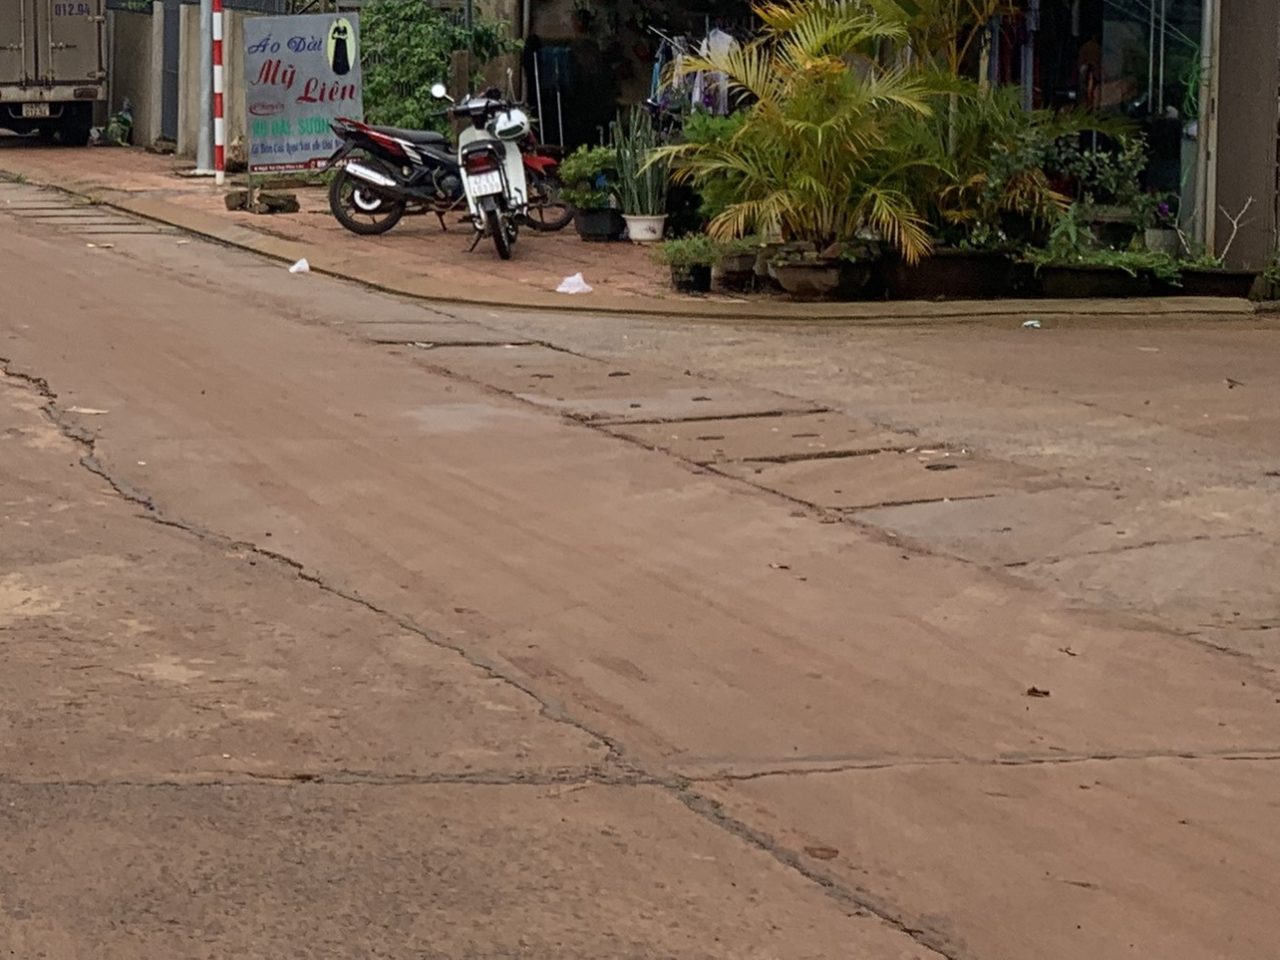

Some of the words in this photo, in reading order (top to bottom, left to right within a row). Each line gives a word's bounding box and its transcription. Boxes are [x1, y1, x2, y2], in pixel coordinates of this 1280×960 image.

[247, 33, 281, 55] Áo
[250, 58, 297, 90] Mỹ
[295, 76, 356, 104] Liên
